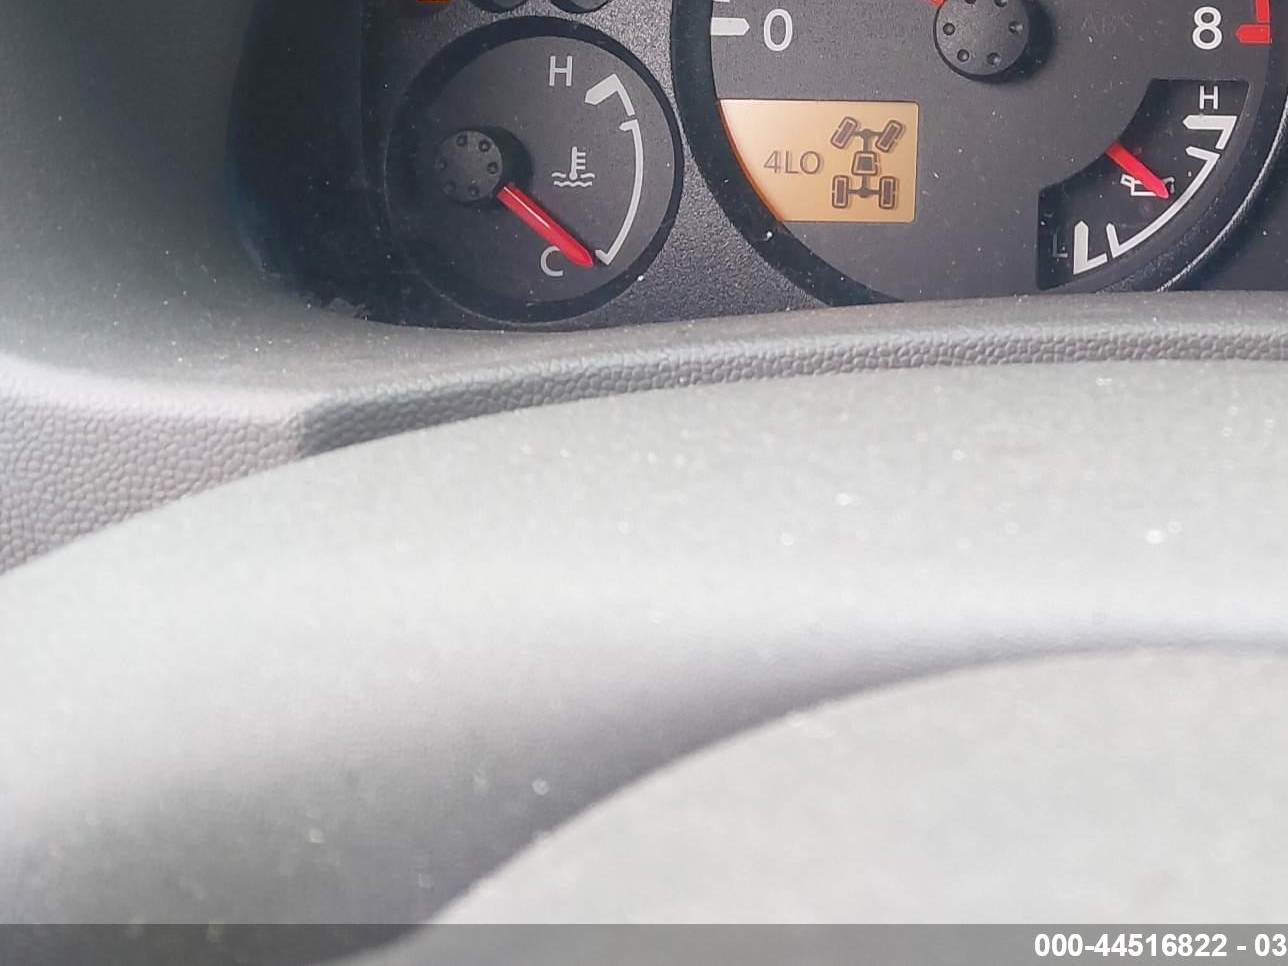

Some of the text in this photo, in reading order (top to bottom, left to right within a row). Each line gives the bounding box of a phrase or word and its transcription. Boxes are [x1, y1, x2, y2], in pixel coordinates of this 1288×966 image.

[764, 9, 792, 51] 0
[1193, 7, 1222, 49] 8
[549, 56, 572, 86] H
[1200, 86, 1218, 109] H
[764, 150, 821, 175] 4LO
[540, 245, 565, 277] C
